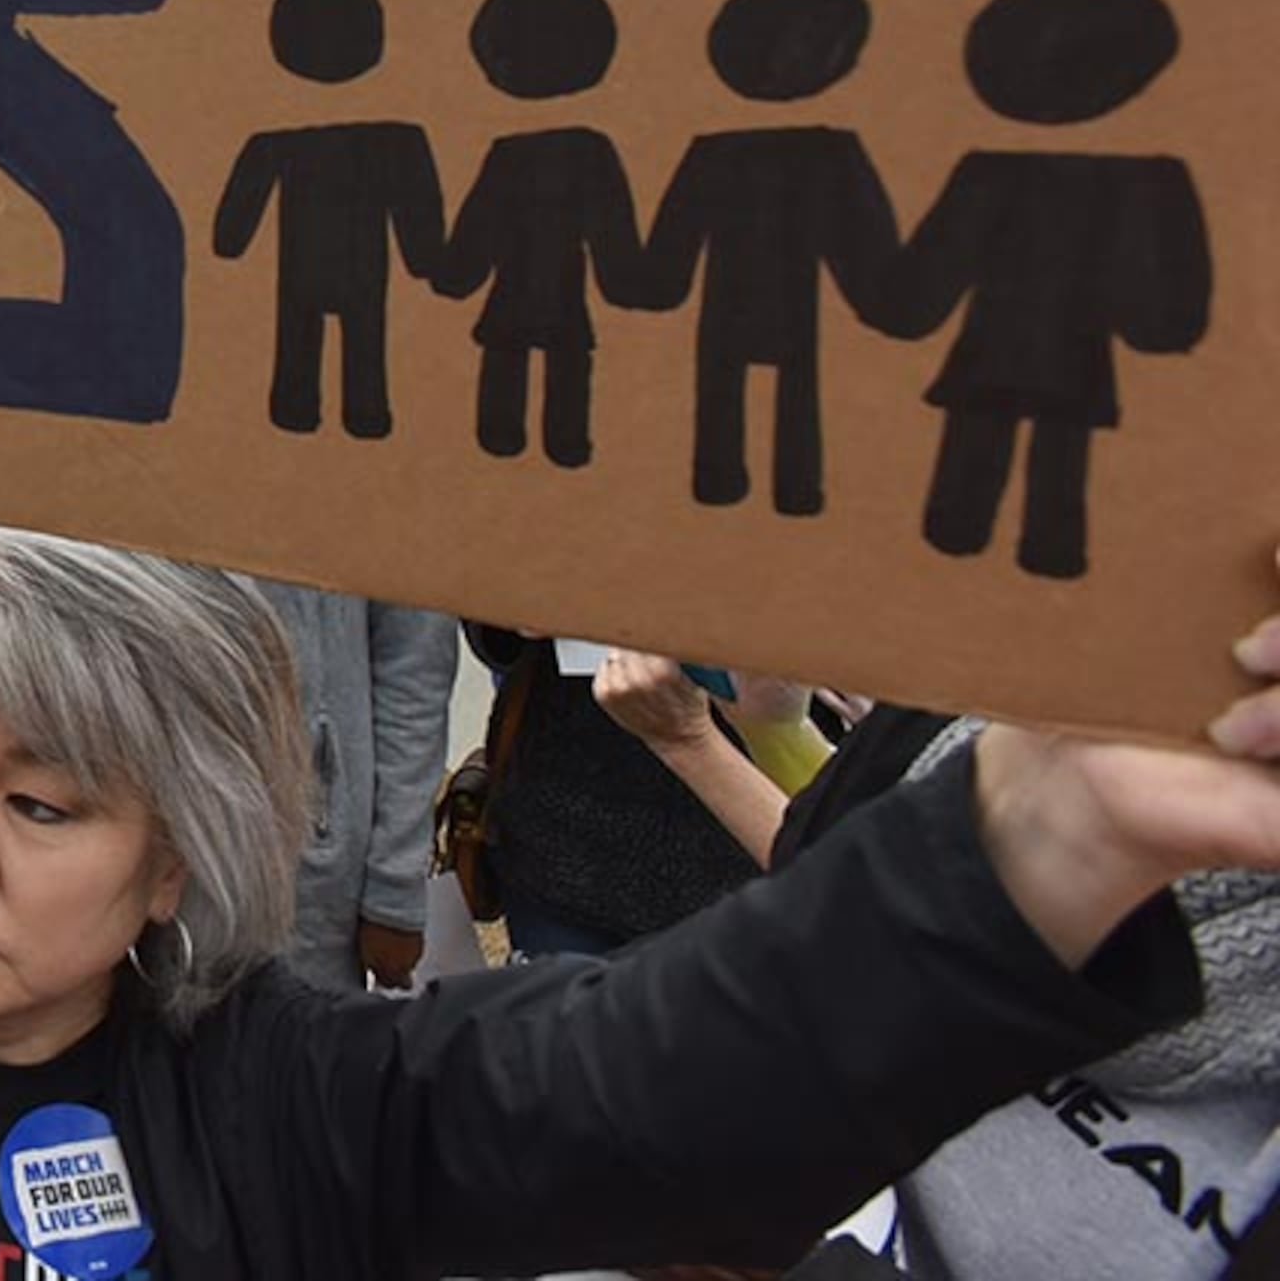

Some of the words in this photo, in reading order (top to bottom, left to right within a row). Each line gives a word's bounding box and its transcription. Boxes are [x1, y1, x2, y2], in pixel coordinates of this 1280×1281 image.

[24, 1151, 104, 1185] MARCH
[29, 1181, 75, 1209] FOR
[75, 1172, 125, 1201] OUR
[36, 1202, 99, 1233] LIVES
